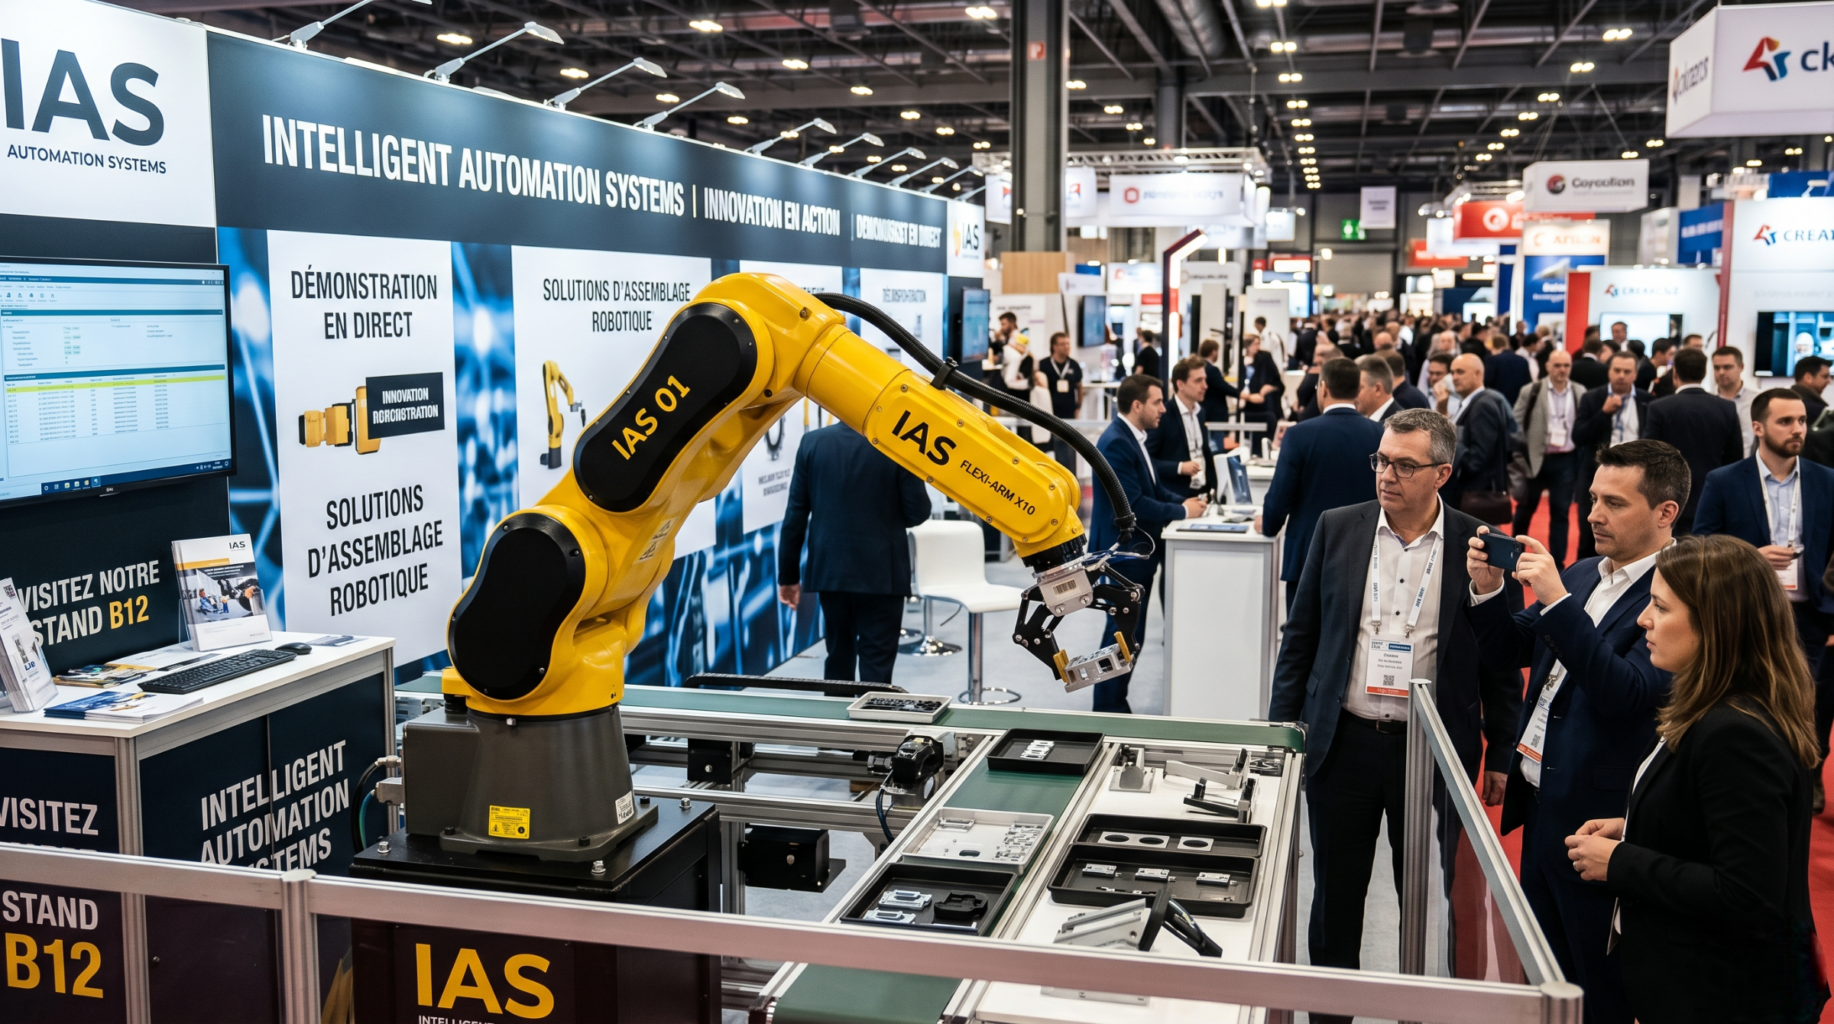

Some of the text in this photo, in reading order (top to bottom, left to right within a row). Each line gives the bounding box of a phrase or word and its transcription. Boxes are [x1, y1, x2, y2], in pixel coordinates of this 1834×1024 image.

[1, 38, 164, 146] IAS
[7, 144, 167, 174] AUTOMATION SYSTEMS
[262, 114, 452, 186] INTELLIGENT
[459, 147, 601, 206] AUTOMATION
[605, 170, 685, 217] SYSTEMS
[704, 187, 783, 228] INNOVATION
[784, 201, 800, 232] EN
[801, 204, 840, 236] ACTION
[962, 221, 979, 250] IAS
[291, 264, 437, 299] DÉMONSTRATION
[543, 278, 691, 302] SOLUTIONS D'ASSEMBLAGE
[324, 311, 412, 339] EN DIRECT
[592, 310, 652, 333] ROBOTIQUE
[382, 387, 429, 404] INNOVATION
[612, 374, 691, 461] IAS 01
[891, 410, 1036, 517] IAS FLEXI-ARM X10
[326, 484, 424, 530] SOLUTIONS
[229, 541, 246, 550] IAS
[307, 519, 443, 578] D'ASSEMBLAGE
[17, 560, 160, 614] VISITEZ NOTRE
[330, 562, 429, 617] ROBOTIQUE
[31, 605, 103, 648] STAND
[109, 595, 149, 630] B12
[202, 739, 346, 831] INTELLIGENT
[201, 778, 349, 866] AUTOMATION
[2, 890, 99, 931] STAND
[4, 932, 104, 999] B12
[415, 943, 554, 1019] IAS
